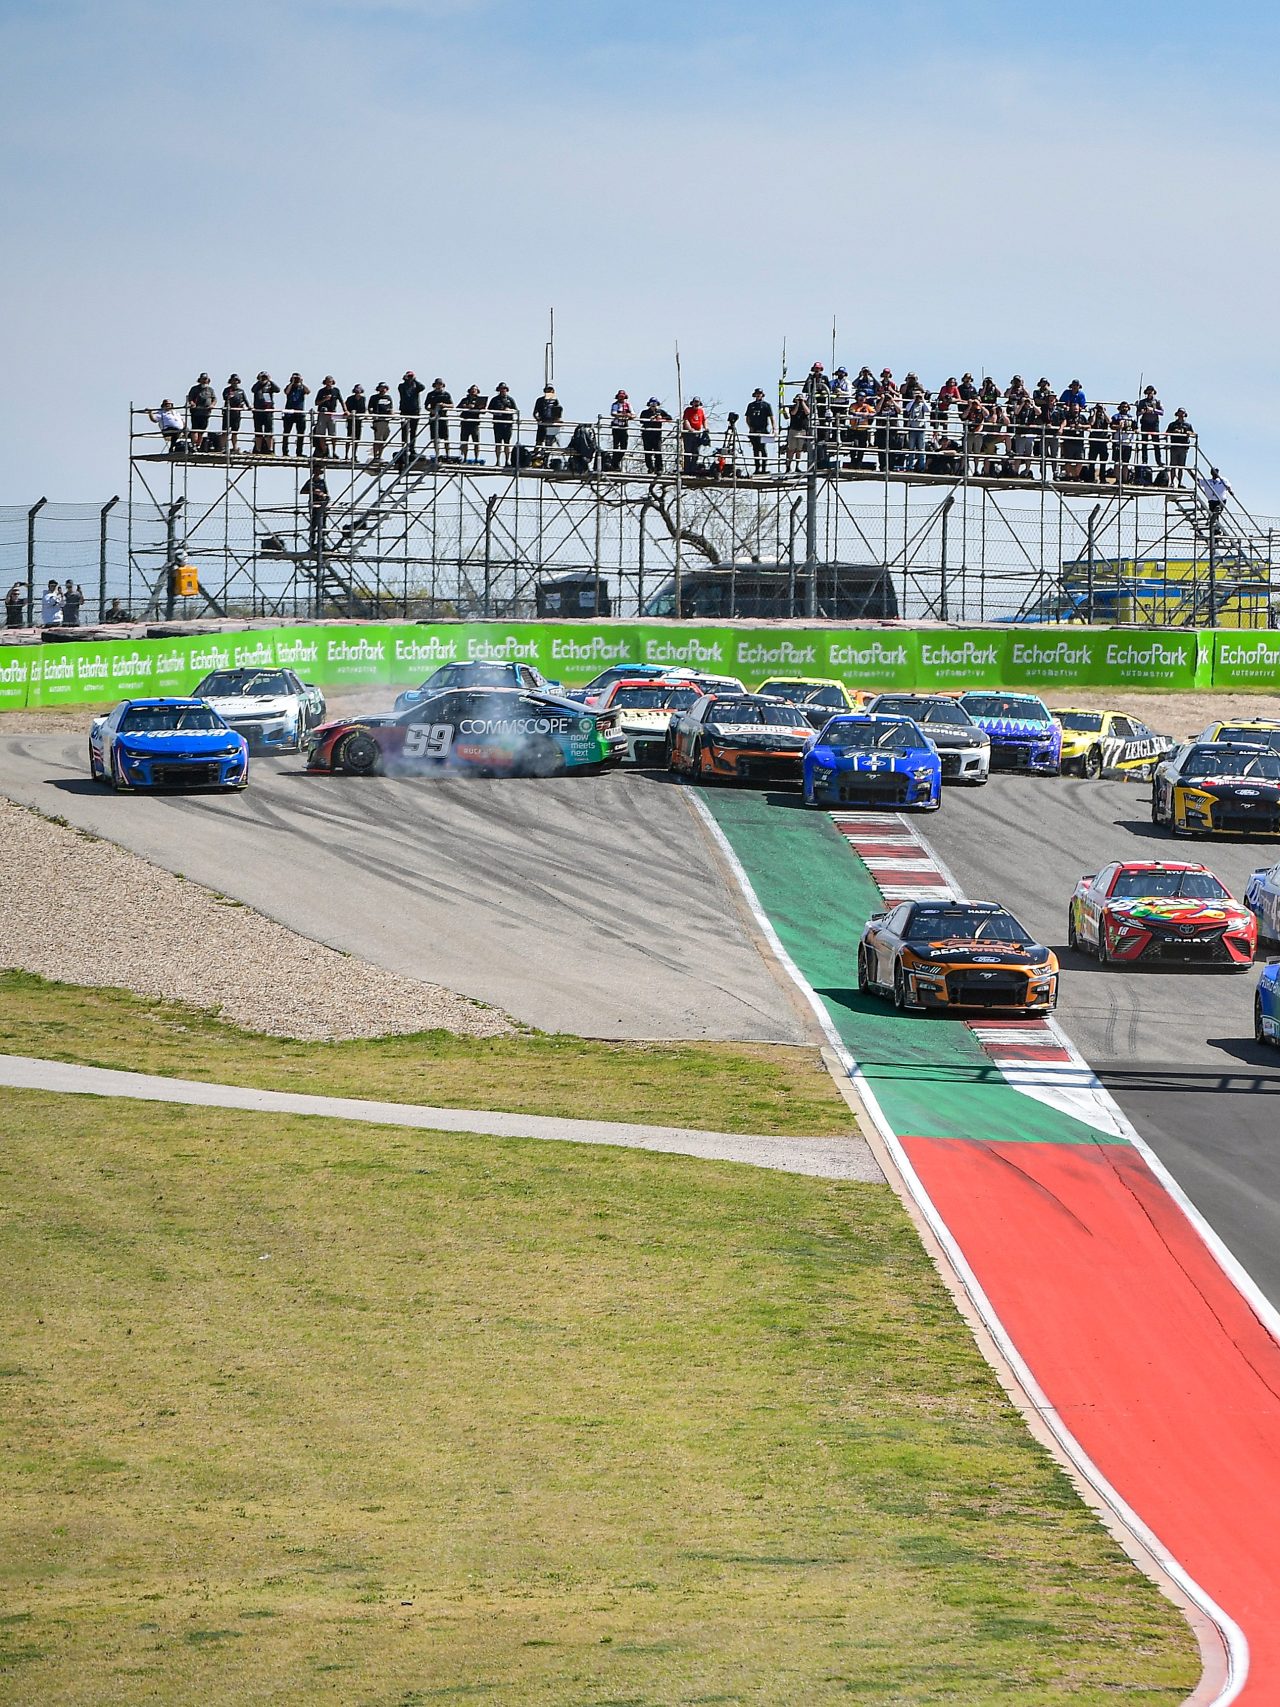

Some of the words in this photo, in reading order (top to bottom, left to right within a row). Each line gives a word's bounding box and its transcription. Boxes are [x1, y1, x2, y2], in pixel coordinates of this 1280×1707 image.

[327, 638, 385, 662] EchoPark
[395, 636, 457, 661] EchoPark
[467, 635, 540, 660] EchoPark
[551, 636, 631, 660] EchoPark
[646, 638, 723, 662] EchoPark
[737, 641, 818, 665] EchoPark
[829, 641, 908, 666] EchoPark
[922, 641, 998, 665] EchoPark
[1012, 641, 1092, 665] EchoPark
[1106, 643, 1186, 666] EchoPark
[1120, 669, 1174, 678] AUTOMOTIVE
[1231, 669, 1276, 677] AUTOMOTIVE
[459, 717, 569, 735] COMMSCOPE
[570, 733, 590, 741] now
[402, 722, 456, 760] 99
[570, 741, 596, 749] meets
[570, 749, 589, 757] next
[1102, 737, 1126, 769] 77
[131, 759, 140, 768] 5
[717, 750, 724, 758] 7
[1117, 926, 1129, 936] 18
